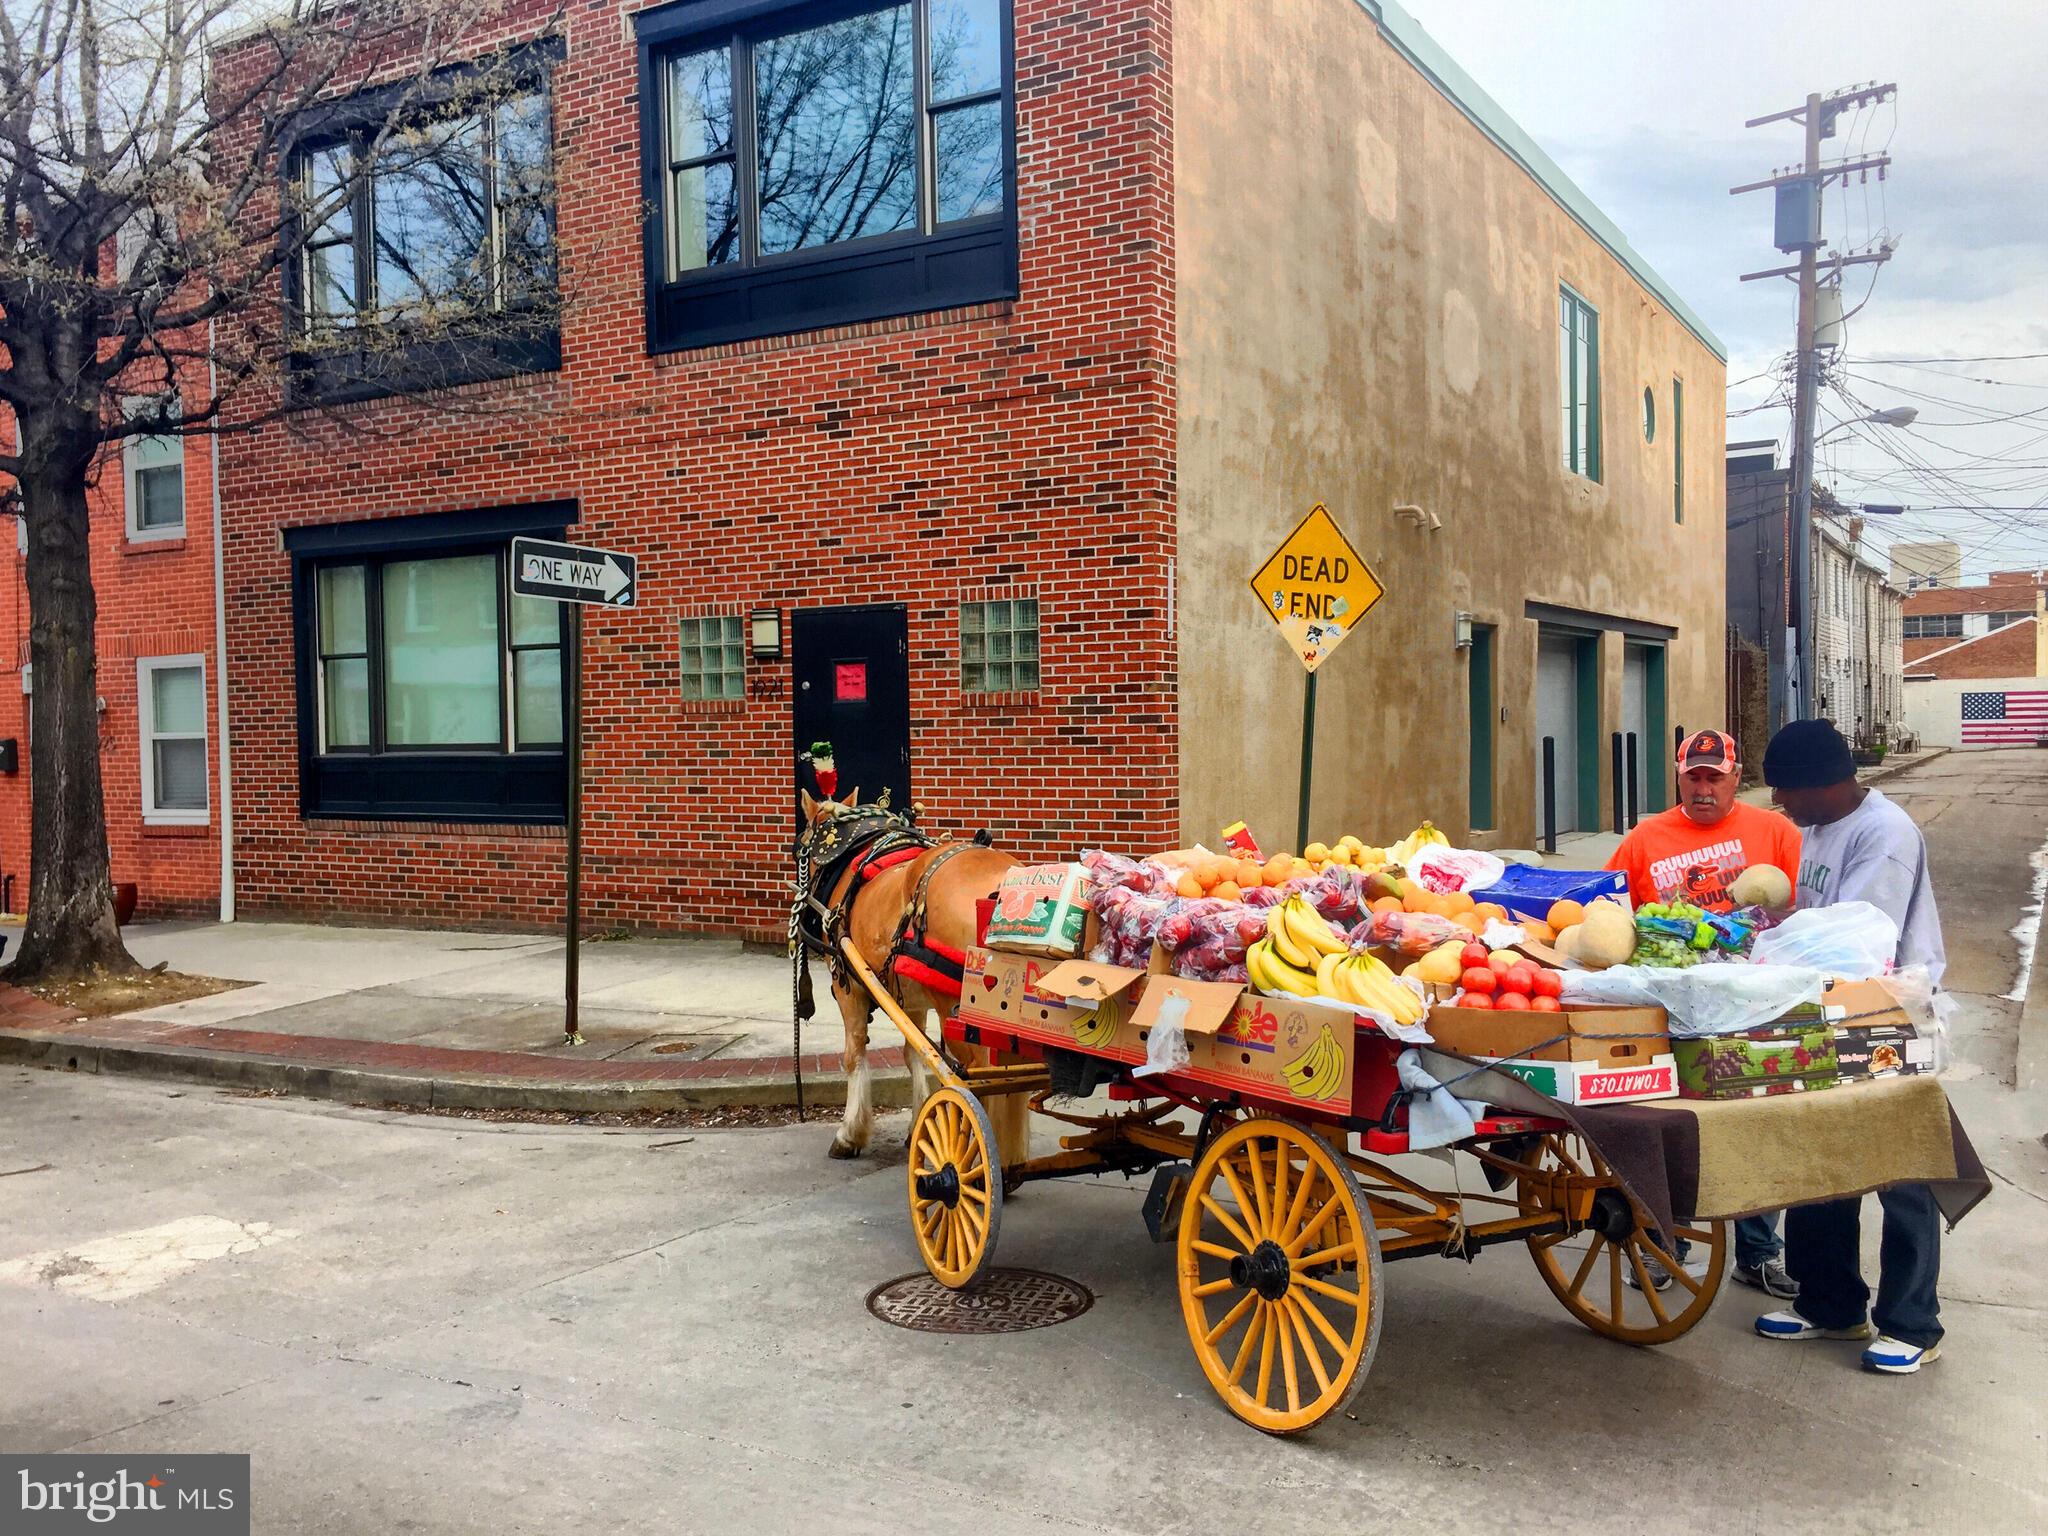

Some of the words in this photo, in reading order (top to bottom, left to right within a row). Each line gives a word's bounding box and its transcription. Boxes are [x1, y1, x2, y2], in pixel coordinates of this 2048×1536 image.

[528, 559, 562, 581] ONE
[569, 563, 602, 586] WAY
[1283, 555, 1349, 584] DEAD
[1290, 592, 1338, 620] END
[1589, 1072, 1660, 1095] TOMATOES
